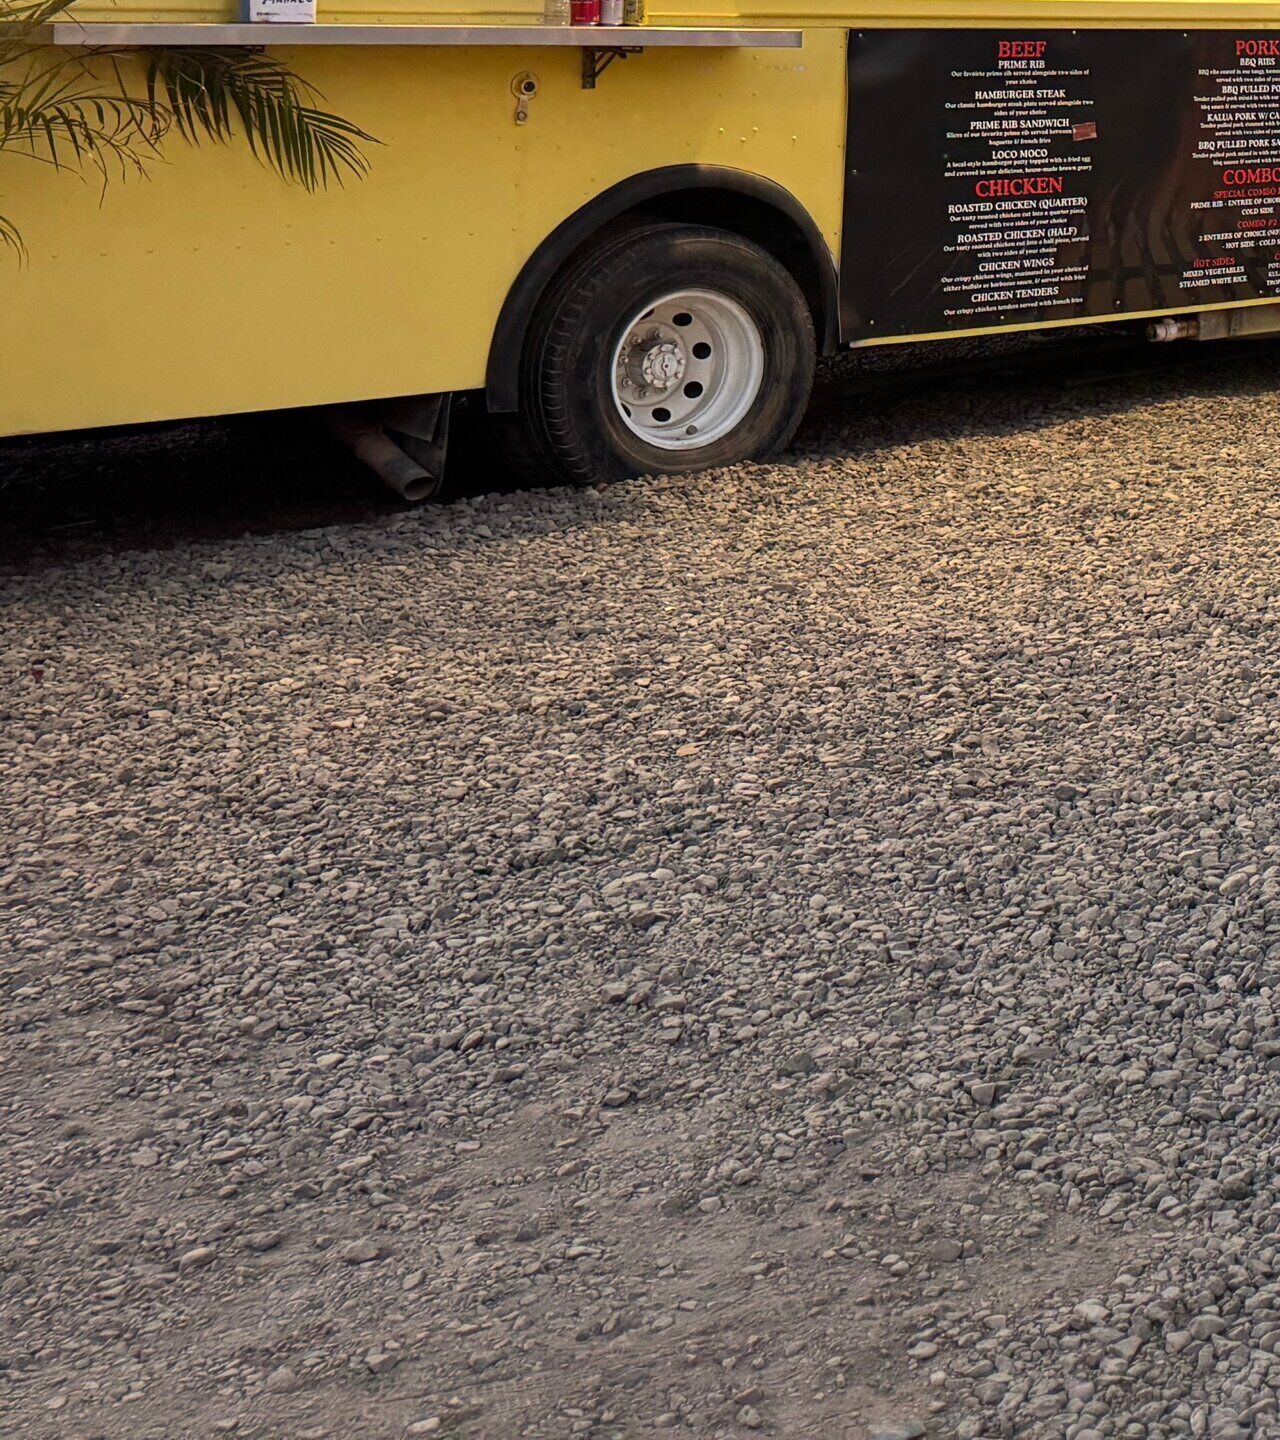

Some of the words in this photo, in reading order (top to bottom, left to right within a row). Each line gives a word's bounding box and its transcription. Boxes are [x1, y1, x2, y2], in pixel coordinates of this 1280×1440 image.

[998, 41, 1047, 57] BEEF
[1236, 40, 1280, 55] PORK
[998, 61, 1027, 69] PRIME
[1240, 58, 1256, 66] BBQ
[975, 90, 1034, 99] HAMBURGER
[1037, 90, 1066, 98] STEAK
[1222, 86, 1238, 94] BBQ
[1240, 85, 1269, 93] PULLED
[1207, 113, 1233, 121] KALUA
[1258, 112, 1267, 120] W/
[970, 121, 1000, 130] PRIME
[1002, 120, 1017, 128] RIB
[1020, 119, 1069, 128] SANDWICH
[1199, 142, 1215, 150] BBQ
[1217, 141, 1247, 149] PULLED
[1249, 139, 1269, 147] PORK
[992, 150, 1017, 159] LOCO
[1020, 149, 1047, 158] MOCO
[975, 177, 1062, 197] CHICKEN
[1214, 190, 1247, 199] SPECIAL
[1248, 188, 1277, 196] COMBO
[948, 203, 993, 213] ROASTED
[995, 200, 1036, 210] CHICKEN
[1039, 197, 1087, 209] (QUARTER)
[958, 233, 1001, 243] ROASTED
[1004, 230, 1045, 240] CHICKEN
[1047, 227, 1077, 237] (HALF)
[979, 261, 1020, 271] CHICKEN
[1023, 258, 1054, 268] WINGS
[1194, 259, 1210, 267] HOT
[1212, 258, 1235, 266] SIDES
[1183, 270, 1203, 278] MIXED
[1205, 266, 1244, 275] VEGETABLES
[971, 292, 1013, 302] CHICKEN
[1016, 287, 1059, 298] TENDERS
